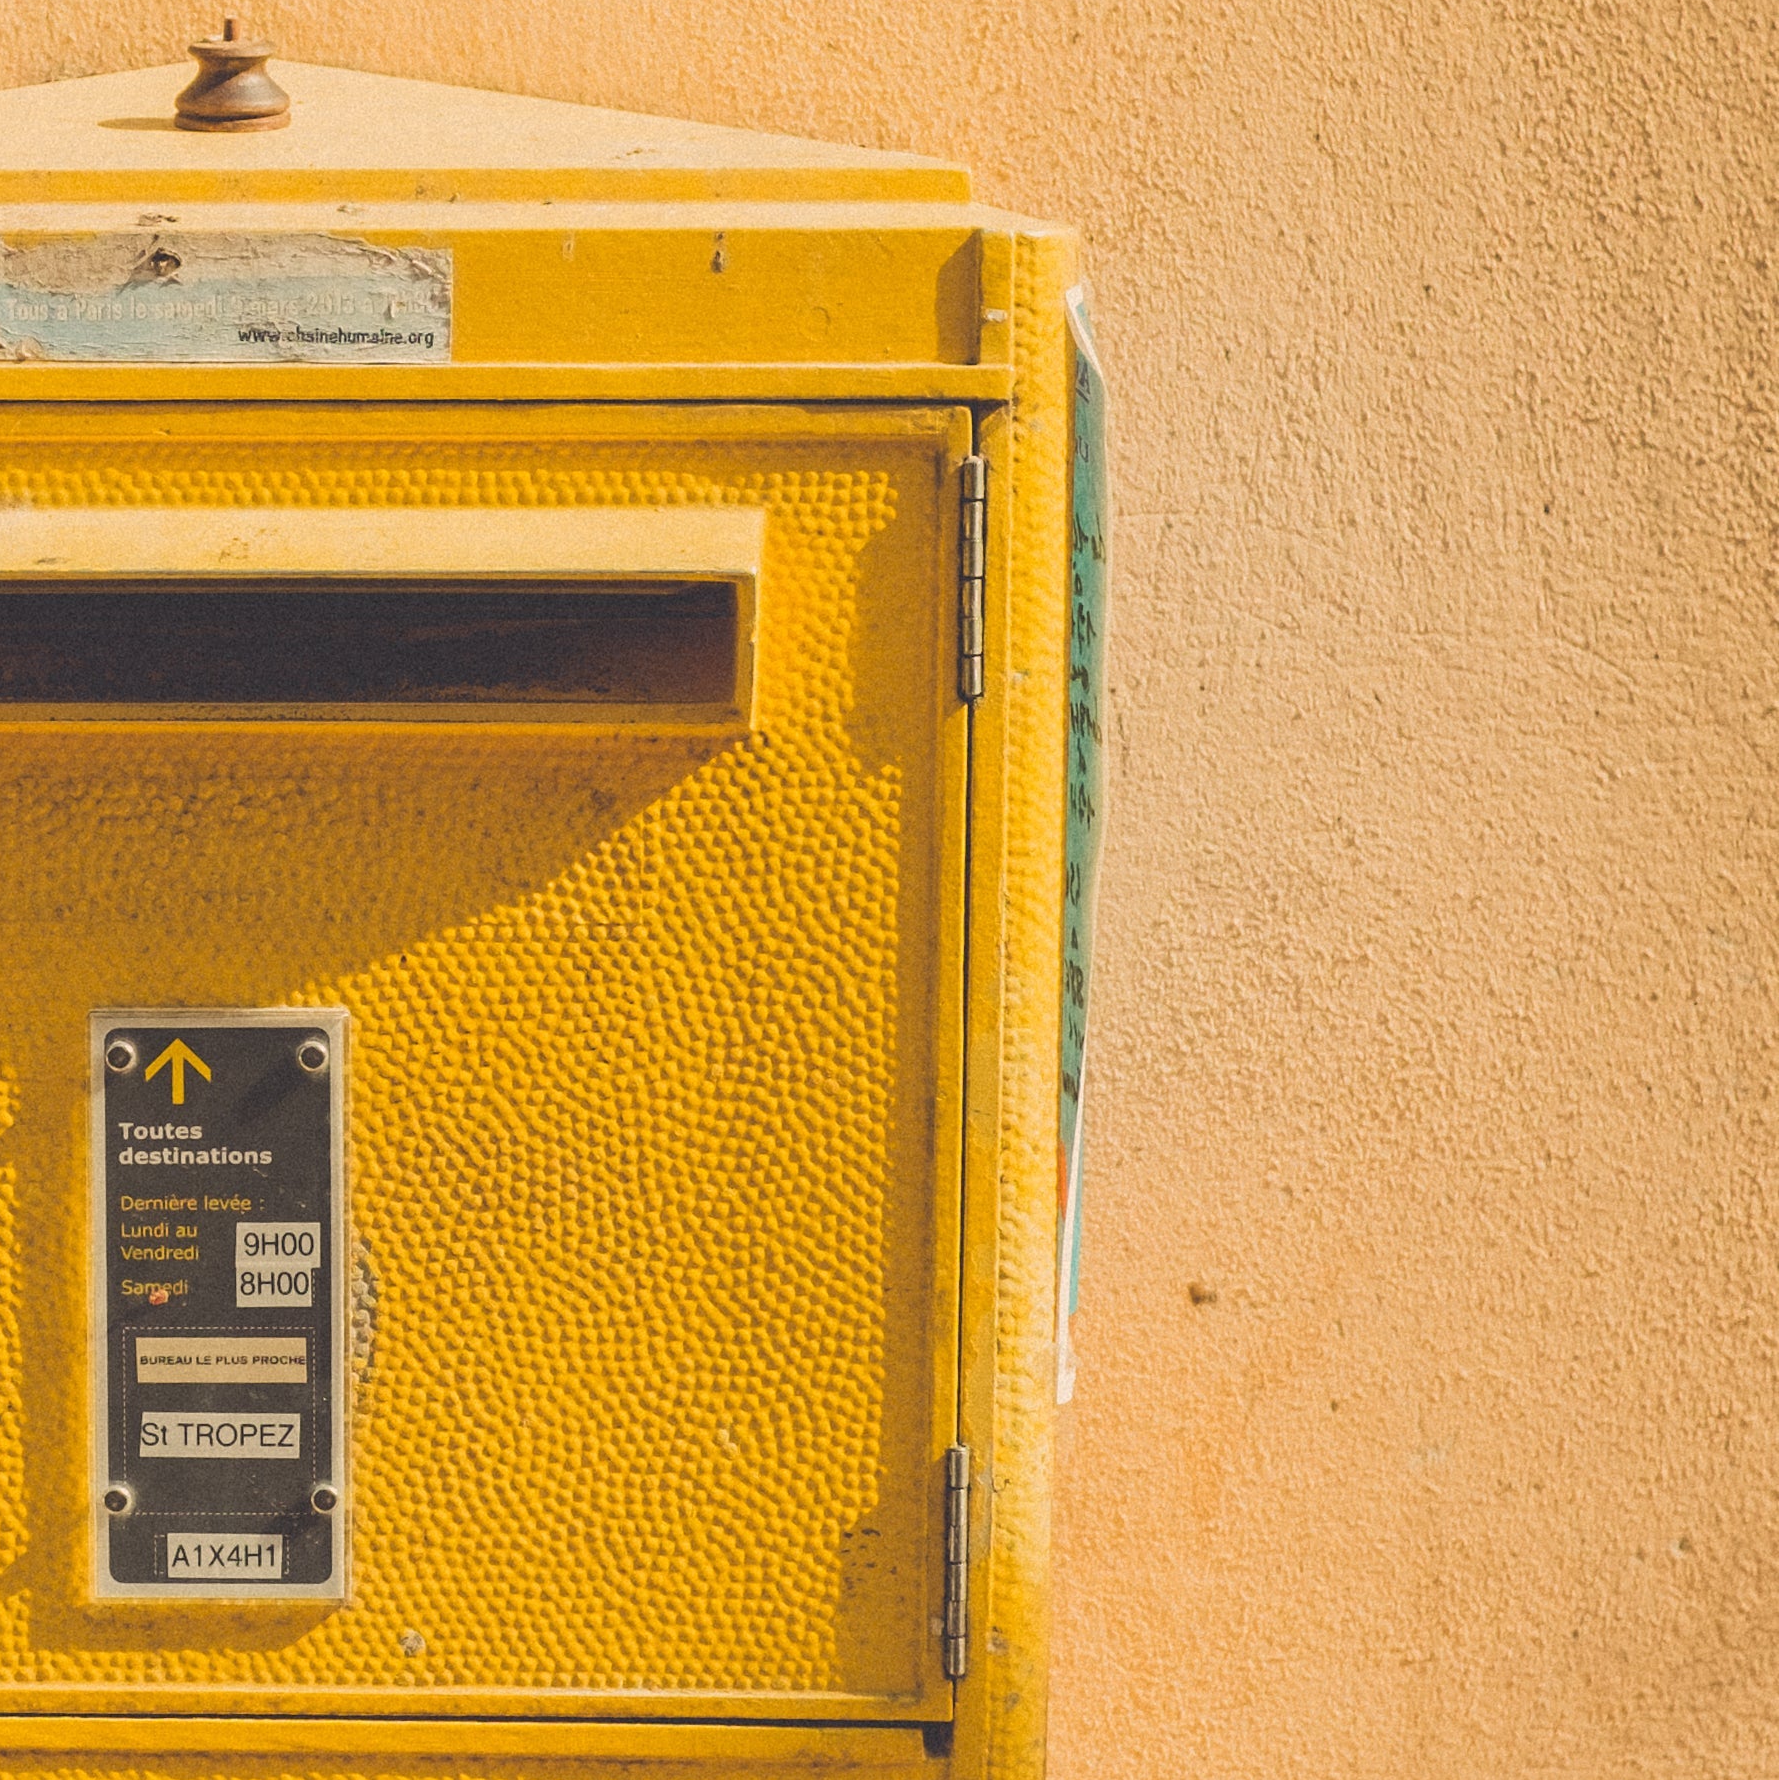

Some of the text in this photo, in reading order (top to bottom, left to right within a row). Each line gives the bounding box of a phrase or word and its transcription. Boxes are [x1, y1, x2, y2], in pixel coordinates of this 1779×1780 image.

[7, 297, 49, 321] Tous
[76, 295, 123, 321] Paris
[131, 296, 147, 320] le
[118, 1122, 203, 1140] Toutes
[118, 1147, 273, 1165] destinations
[121, 1194, 198, 1211] Dernière
[204, 1194, 252, 1211] levée
[121, 1223, 198, 1238] Lundi au
[121, 1245, 200, 1261] Vendredi
[244, 1231, 315, 1257] 9H00
[121, 1279, 189, 1296] Samedi
[240, 1271, 310, 1296] 8H00
[140, 1355, 306, 1366] BUREAU LE PLUS PROCHE
[141, 1422, 295, 1448] St TROPEZ
[171, 1543, 276, 1567] A1X4H1
